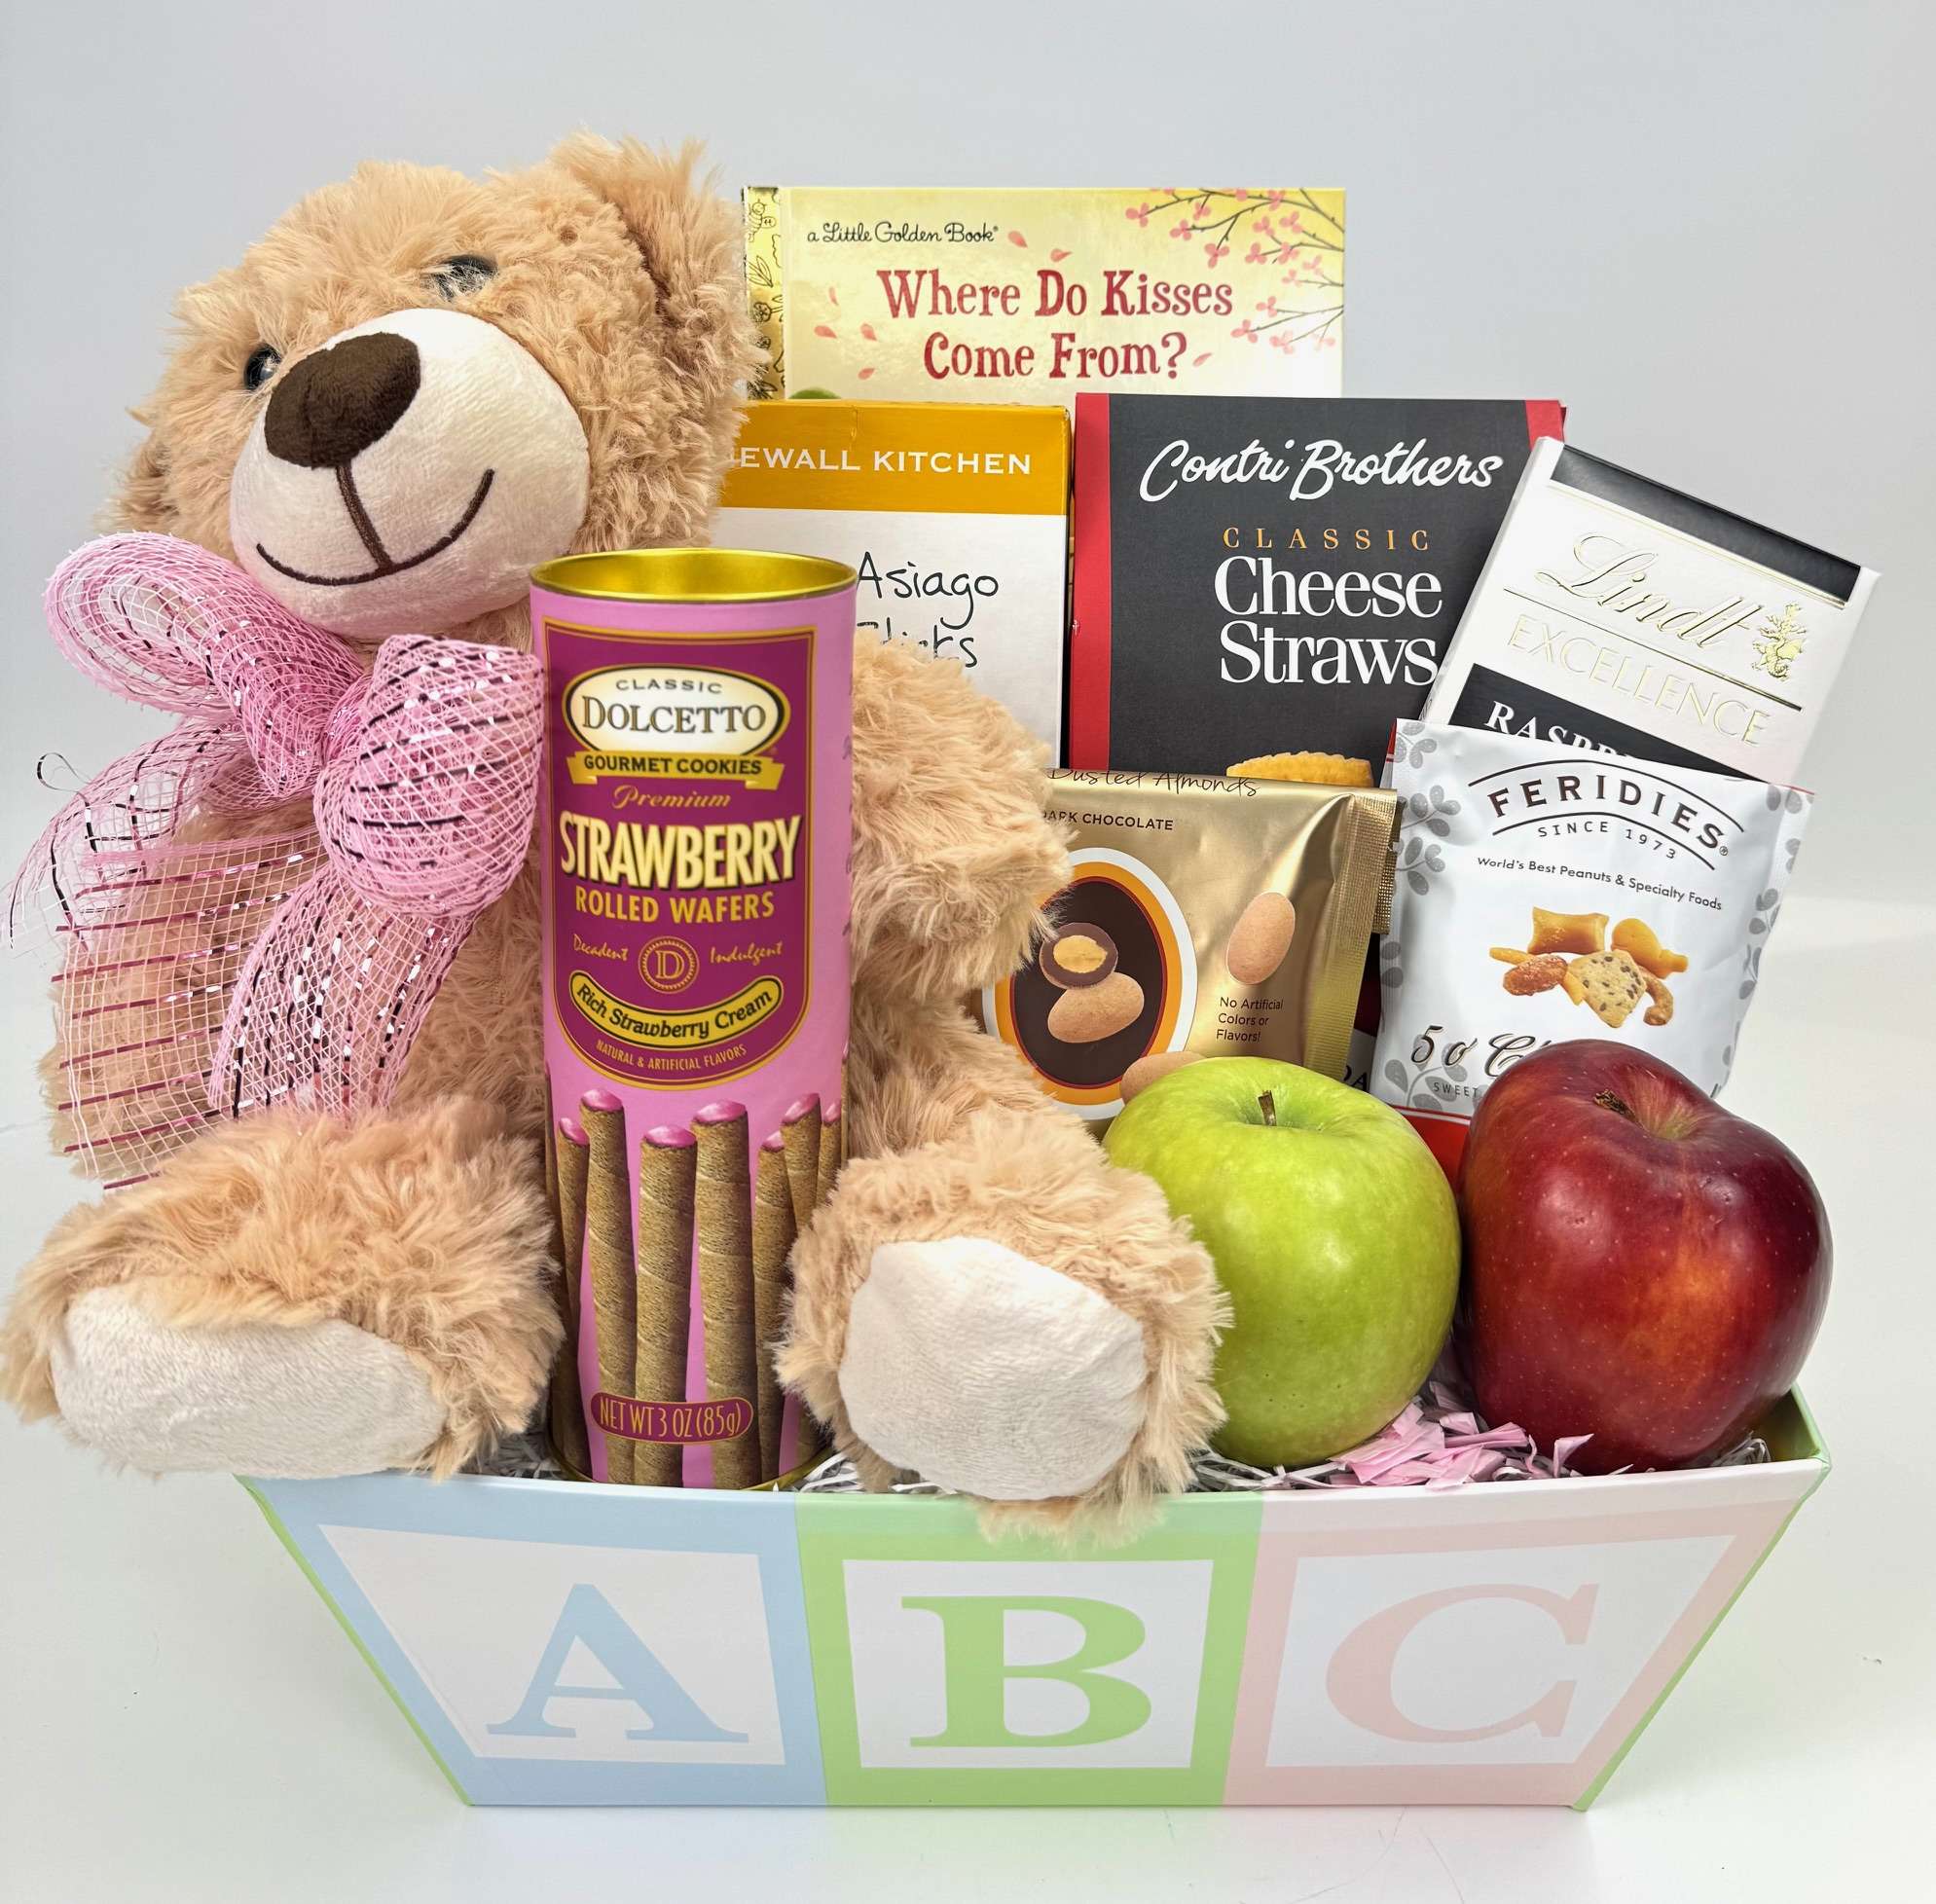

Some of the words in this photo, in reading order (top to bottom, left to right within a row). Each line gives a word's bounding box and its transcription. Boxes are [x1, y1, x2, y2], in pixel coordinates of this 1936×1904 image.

[807, 231, 820, 242] a
[822, 222, 872, 242] Little
[874, 221, 942, 242] Golden
[877, 270, 1020, 318] Where
[1035, 270, 1087, 316] Do
[1100, 270, 1233, 316] Kisses
[924, 332, 1034, 380] Come
[1050, 332, 1187, 380] From?
[732, 447, 861, 470] EWALL
[873, 451, 1032, 475] KITCHEN
[1139, 438, 1294, 502] Contri
[1289, 437, 1503, 501] Brothers
[1223, 527, 1429, 551] CLASSIC
[856, 551, 999, 630] Asiago
[1214, 555, 1443, 618] Cheese
[1535, 532, 1763, 649] Lindt
[1220, 620, 1439, 685] Straws
[615, 678, 723, 694] CLASSIC
[1507, 613, 1772, 747] EXCELLENCE
[581, 695, 766, 733] DOLCETTO
[584, 755, 673, 773] GOURMET
[676, 758, 762, 775] COOKIES
[611, 784, 731, 810] Premium
[1043, 810, 1078, 824] ARK
[1082, 813, 1174, 830] CHOCOLATE
[560, 810, 803, 891] STRAWBERRY
[1538, 821, 1609, 837] SINCE
[1625, 828, 1677, 860] 1973
[1478, 857, 1524, 870] World's
[1528, 860, 1556, 874] Best
[1559, 865, 1611, 883] Peanuts
[1616, 874, 1626, 886] &
[1628, 878, 1685, 902] Specialty
[1689, 892, 1723, 910] Foods
[575, 886, 660, 923] ROLLED
[670, 891, 775, 924] WAFERS
[572, 934, 630, 962] Decadent
[655, 950, 685, 979] D
[710, 941, 784, 967] Indulgent
[576, 983, 607, 1019] Rich
[609, 1008, 710, 1040] Strawberry
[714, 989, 773, 1030] Cream
[1218, 1012, 1256, 1026] Colors
[1259, 1017, 1269, 1026] or
[1220, 996, 1237, 1007] No
[1241, 999, 1284, 1010] Artificial
[596, 1040, 634, 1066] NATURAL
[637, 1057, 644, 1068] &
[648, 1057, 701, 1071] ARTIFICIAL
[704, 1044, 748, 1067] FLAVORS
[1433, 1081, 1479, 1098] SWEET
[600, 1398, 625, 1431] NET
[629, 1405, 654, 1436] WT
[658, 1408, 667, 1437] 3
[673, 1410, 692, 1438] OZ
[696, 1405, 742, 1437] (85g)
[488, 1583, 749, 1743] A
[900, 1595, 1151, 1747] B
[1325, 1582, 1598, 1741] C
